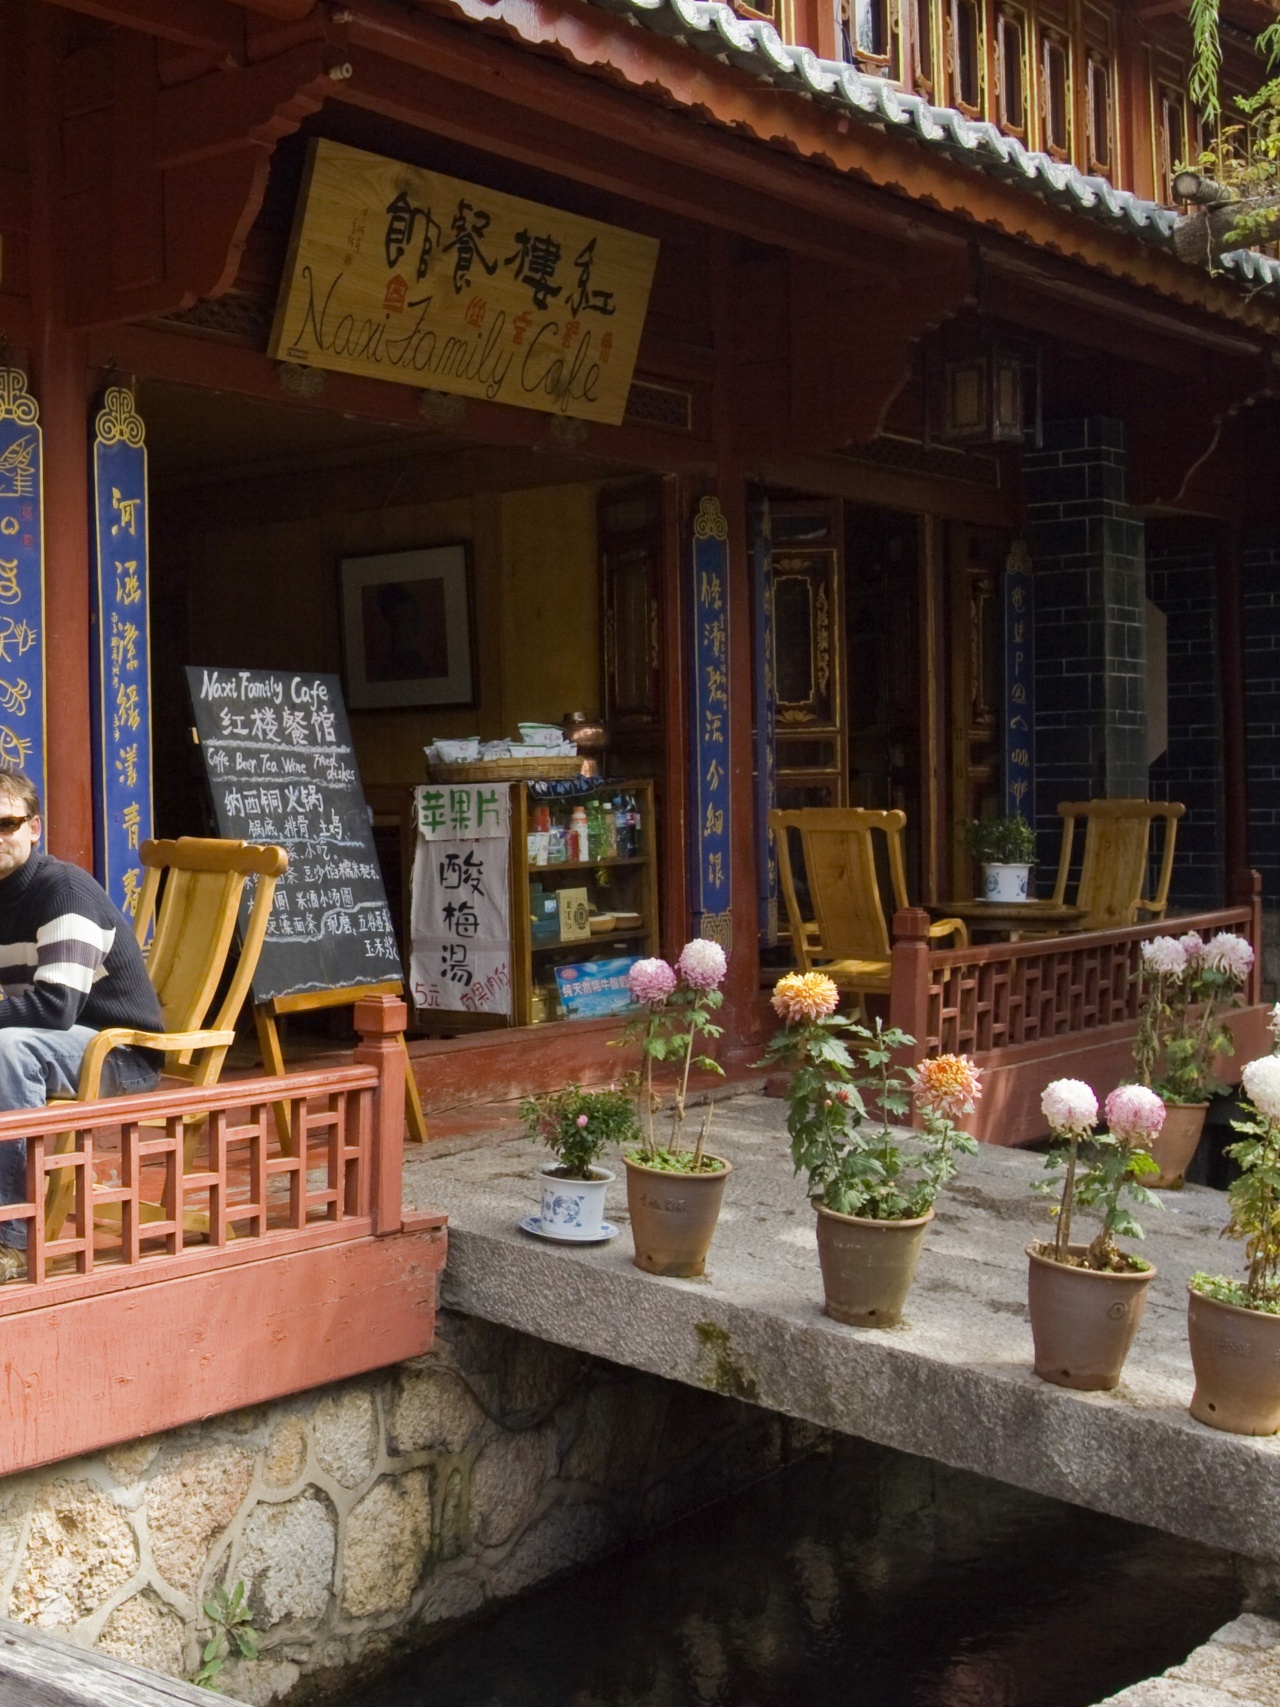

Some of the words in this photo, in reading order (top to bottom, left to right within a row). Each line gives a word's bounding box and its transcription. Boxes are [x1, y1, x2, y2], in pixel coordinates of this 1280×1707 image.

[294, 265, 384, 363] Naxi
[386, 296, 515, 399] Family
[522, 322, 600, 412] Cafe
[200, 670, 237, 701] Naxi
[239, 672, 282, 704] Family
[291, 676, 329, 711] Cafe
[220, 705, 337, 745] 红楼餐馆
[281, 757, 307, 774] Wine
[327, 762, 355, 782] dishes
[224, 785, 324, 817] 纳西铜火锅
[421, 789, 500, 834] 苹果片
[364, 936, 400, 961] 玉米浆
[415, 982, 441, 1007] 5元
